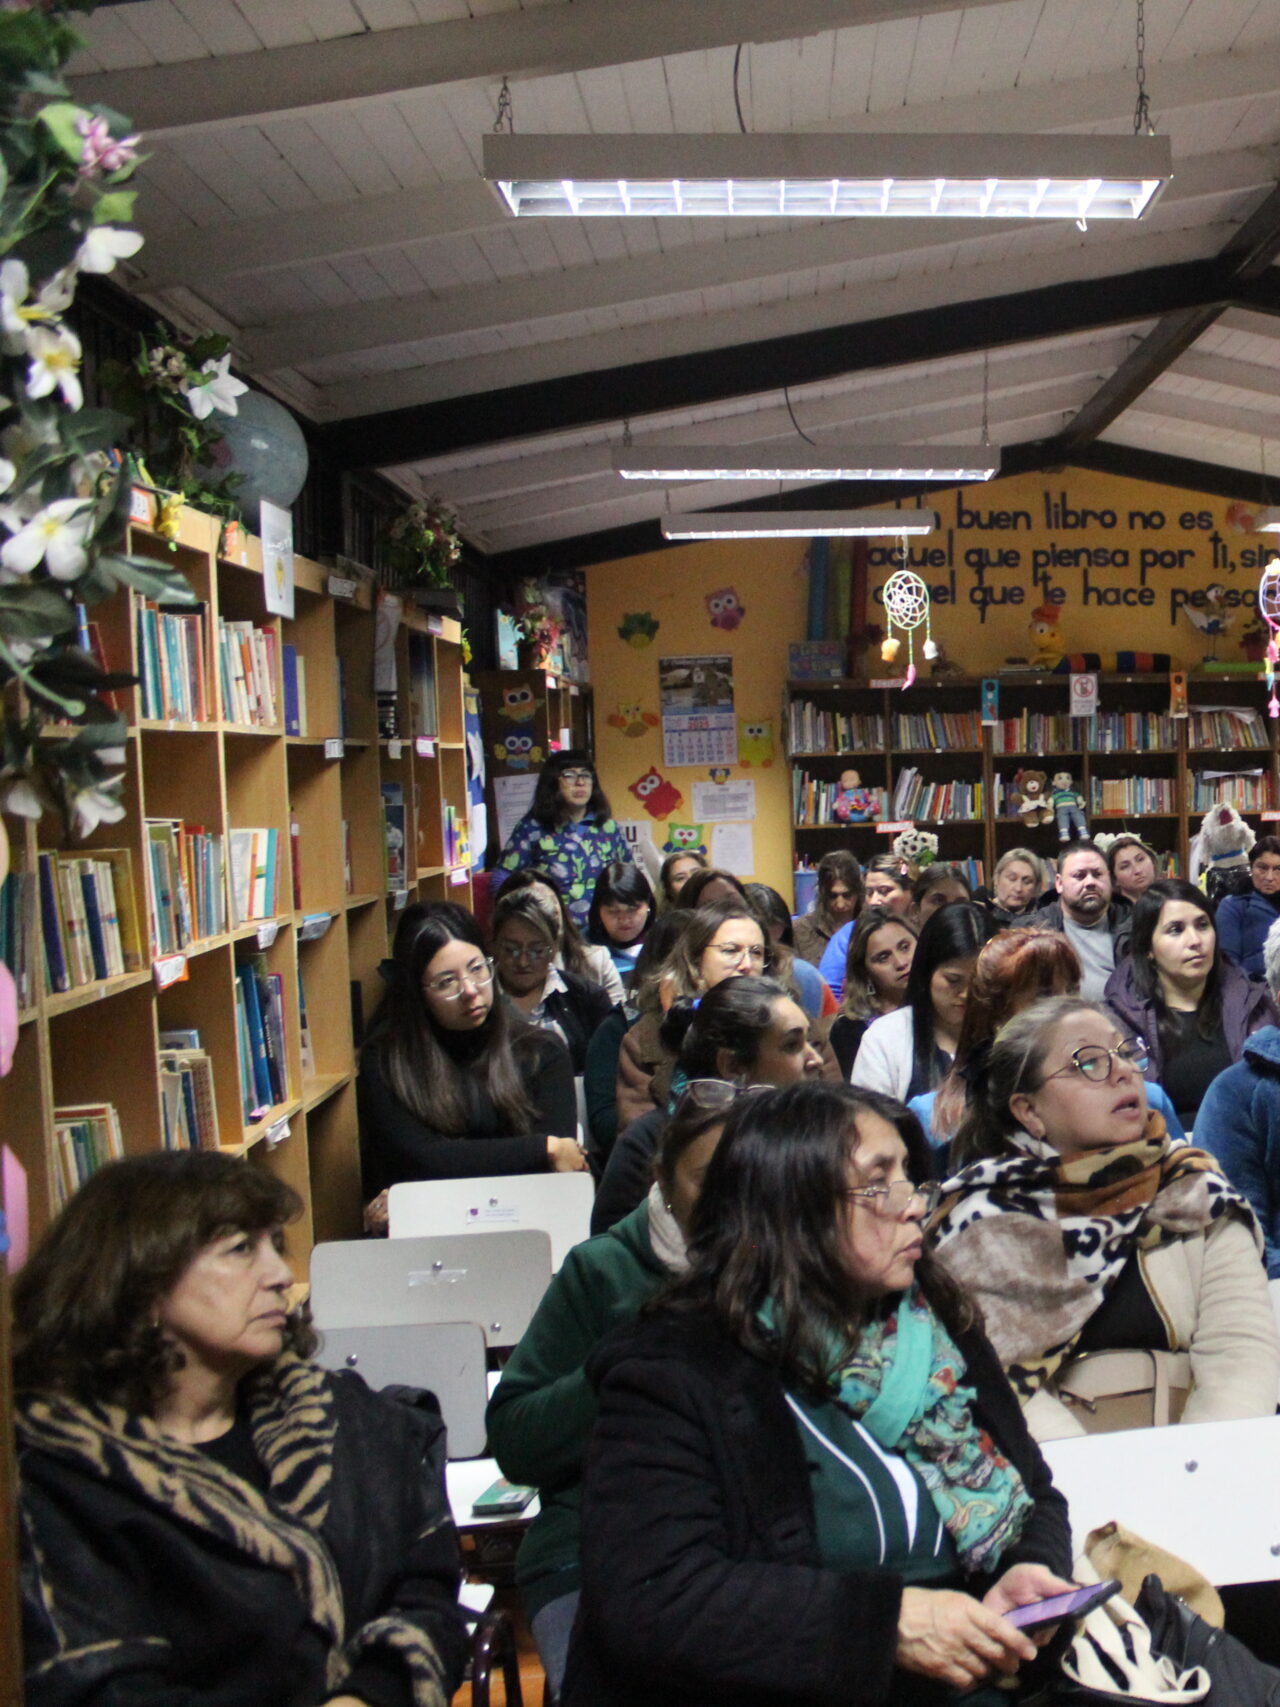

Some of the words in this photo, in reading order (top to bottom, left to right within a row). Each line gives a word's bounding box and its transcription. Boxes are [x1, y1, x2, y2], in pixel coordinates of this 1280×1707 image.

[956, 490, 1032, 530] buen
[1044, 491, 1117, 530] libro
[1128, 510, 1166, 530] no
[1179, 510, 1214, 530] es
[964, 548, 1021, 587] que
[1032, 543, 1129, 587] piensa
[1140, 548, 1195, 586] por
[969, 585, 1025, 624] que
[1038, 571, 1066, 605] te
[1083, 568, 1155, 606] hace
